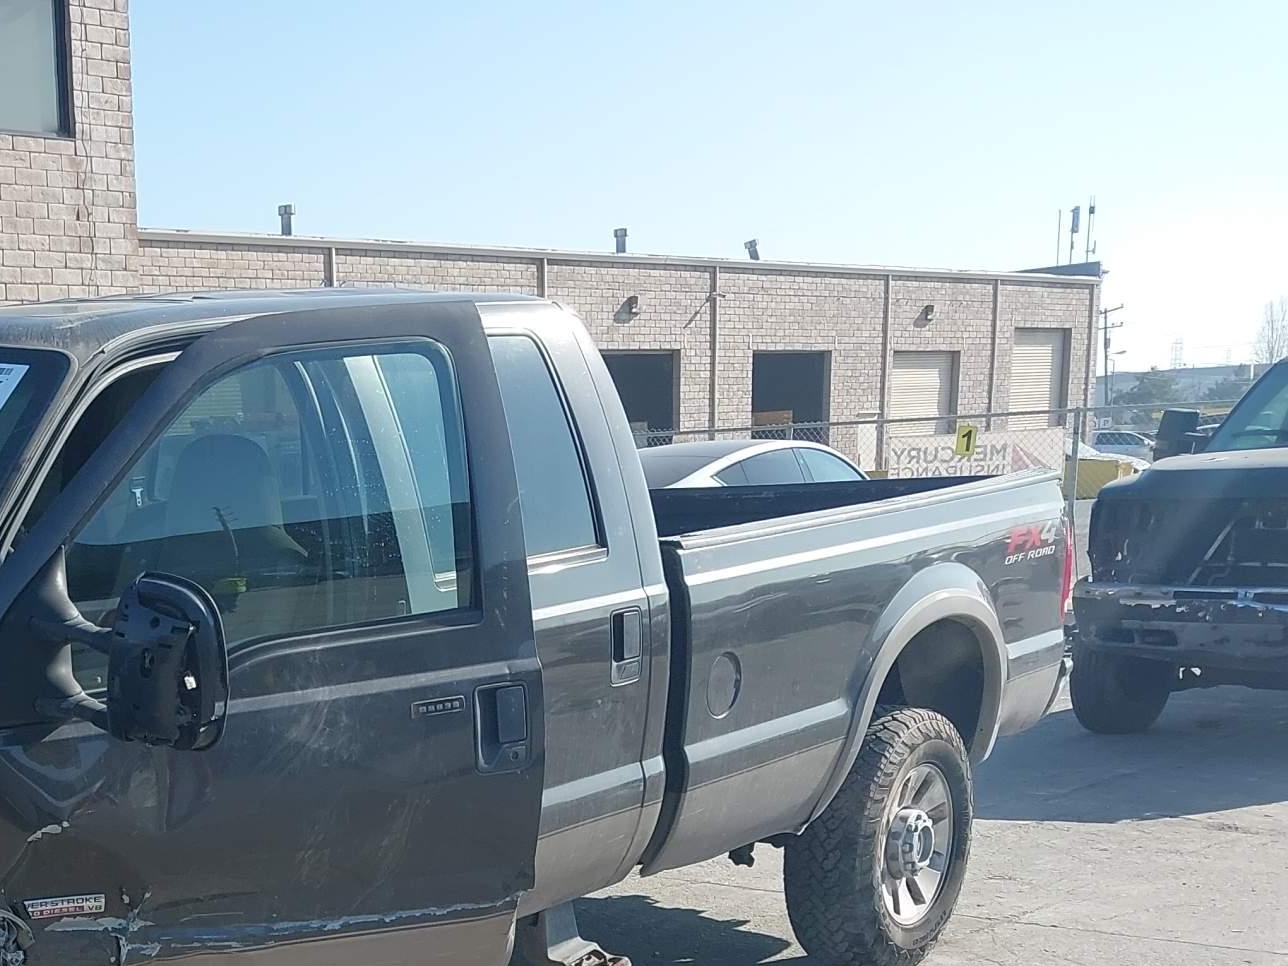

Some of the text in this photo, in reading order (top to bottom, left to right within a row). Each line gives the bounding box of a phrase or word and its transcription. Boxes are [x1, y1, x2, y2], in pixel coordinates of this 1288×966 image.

[962, 430, 972, 451] 1
[1008, 520, 1057, 554] FX4
[1005, 545, 1056, 565] OFF ROAD
[43, 905, 83, 915] DIESEL
